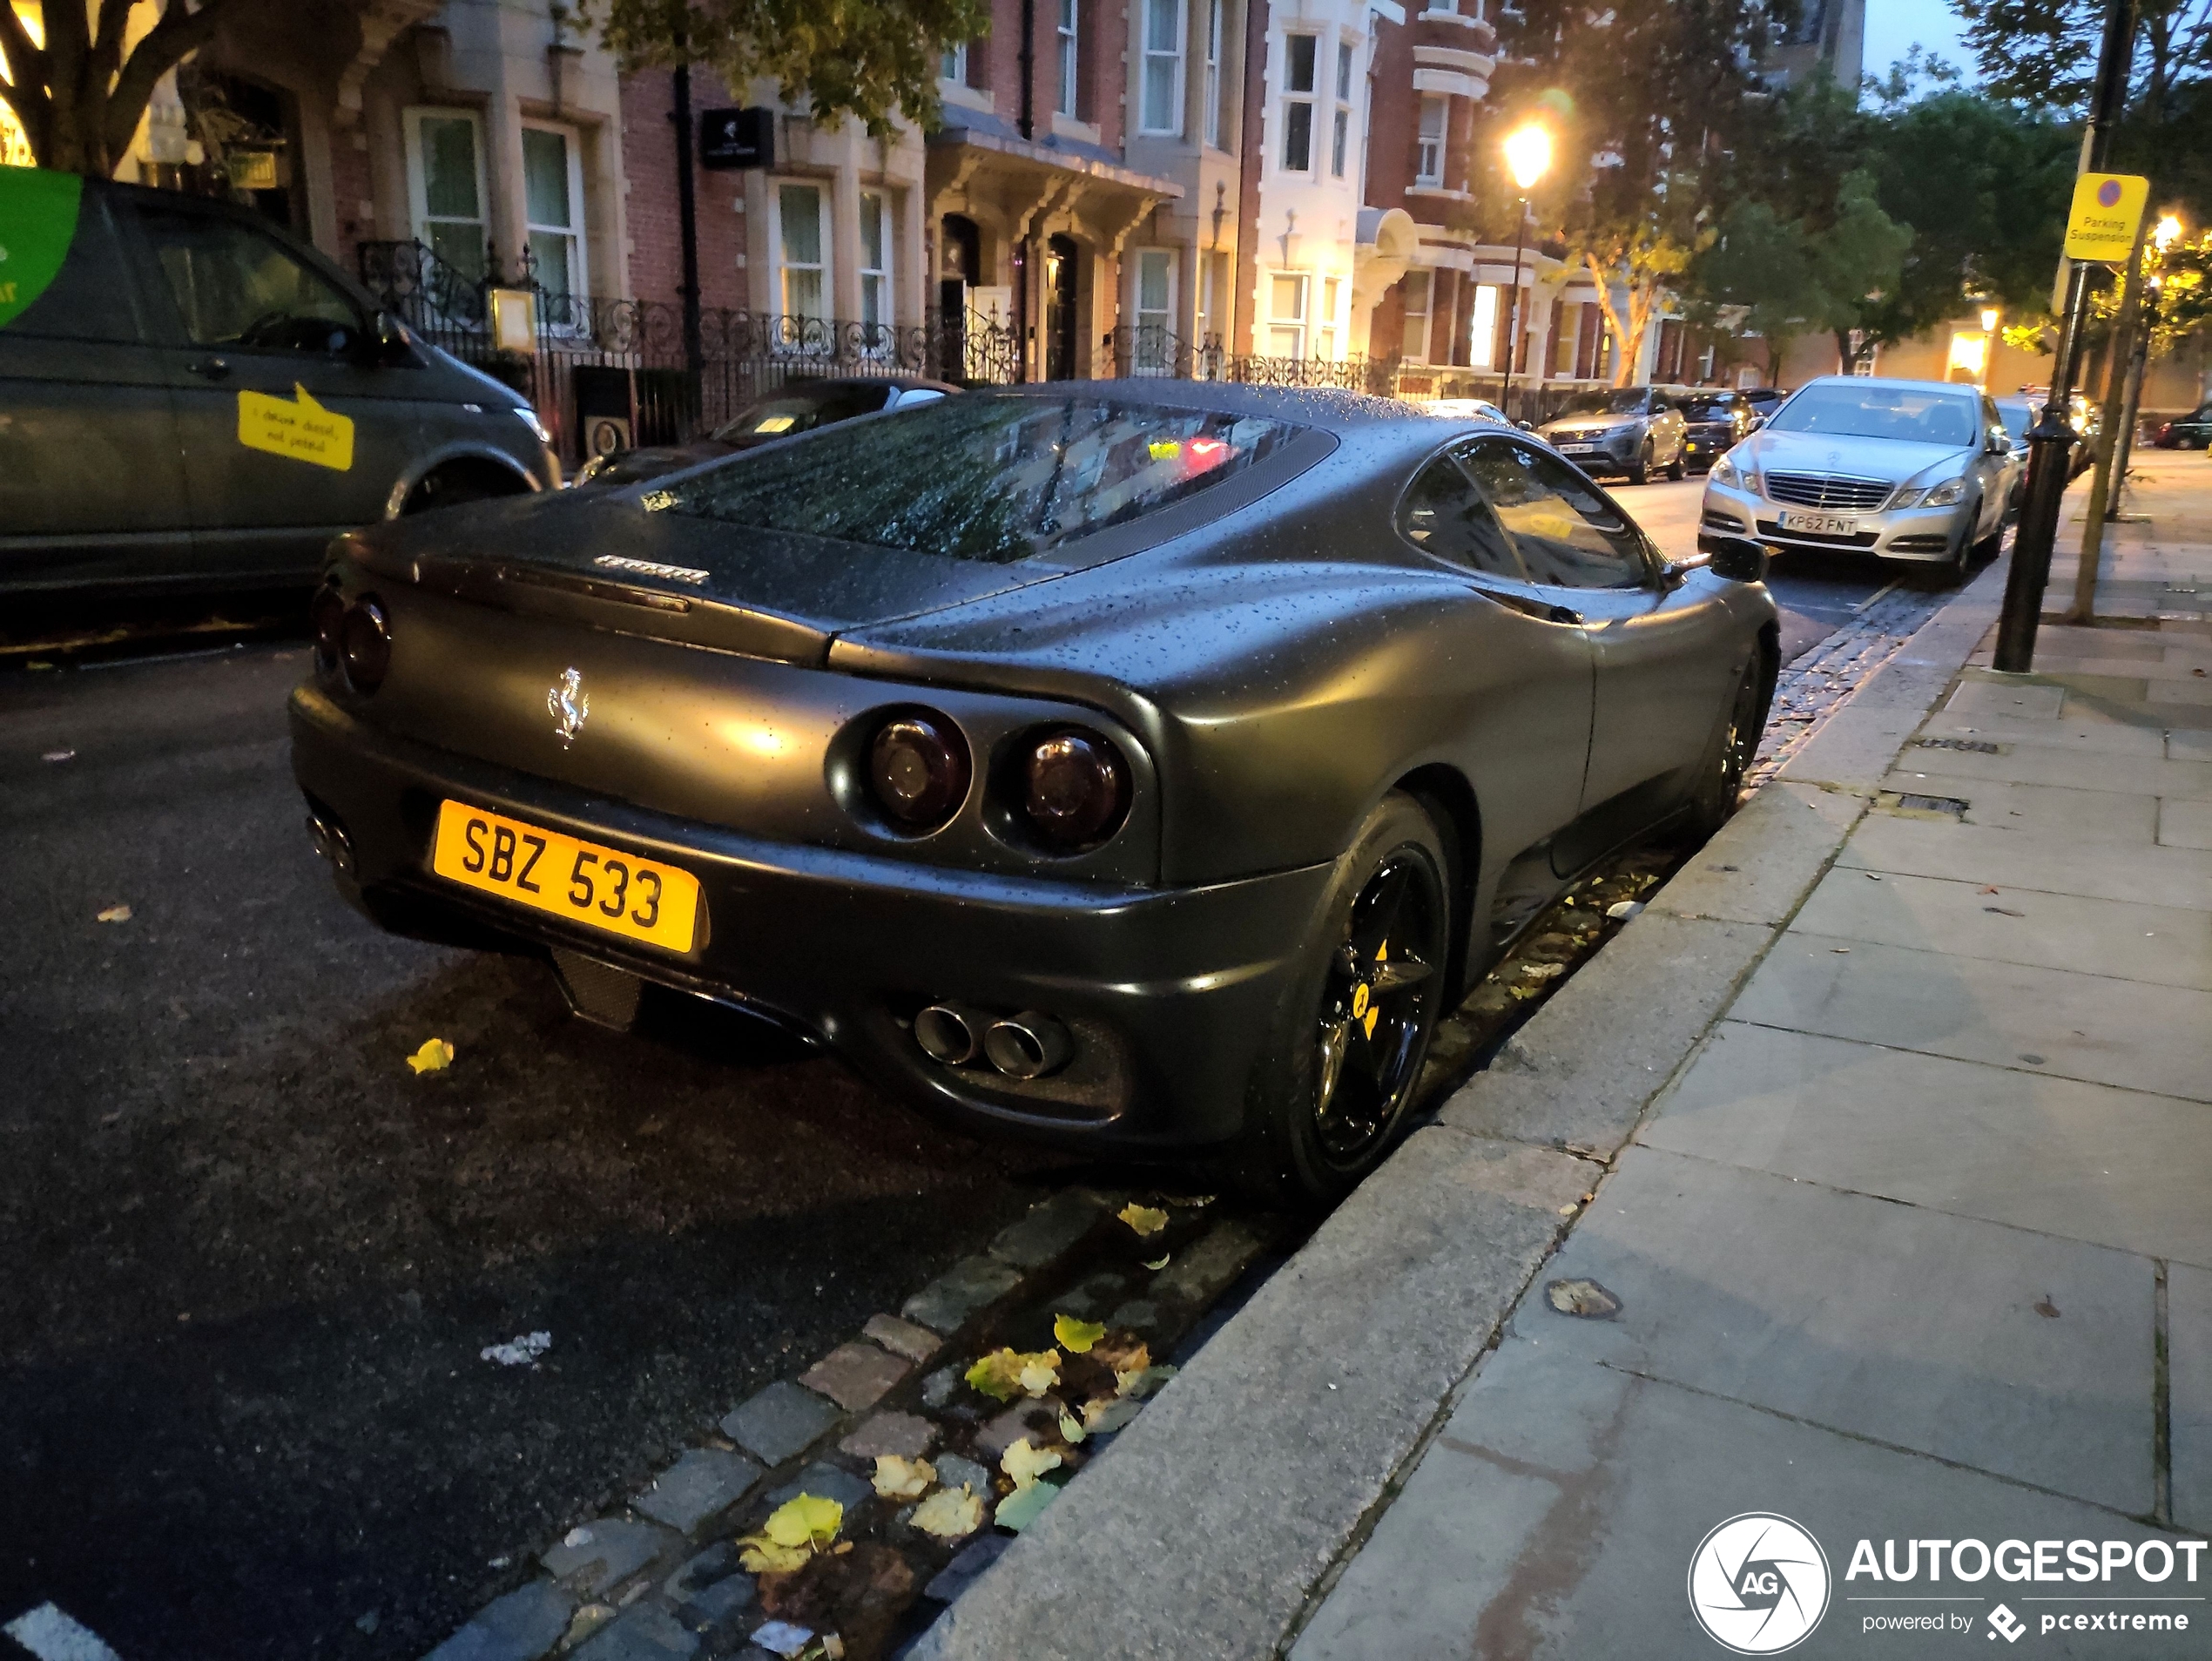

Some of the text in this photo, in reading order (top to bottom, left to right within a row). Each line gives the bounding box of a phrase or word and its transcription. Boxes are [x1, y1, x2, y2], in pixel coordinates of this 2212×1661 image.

[2083, 216, 2126, 231] Parking
[2069, 229, 2132, 242] Suspension
[1787, 515, 1855, 532] KP62 FNT
[462, 818, 662, 928] SBZ 533
